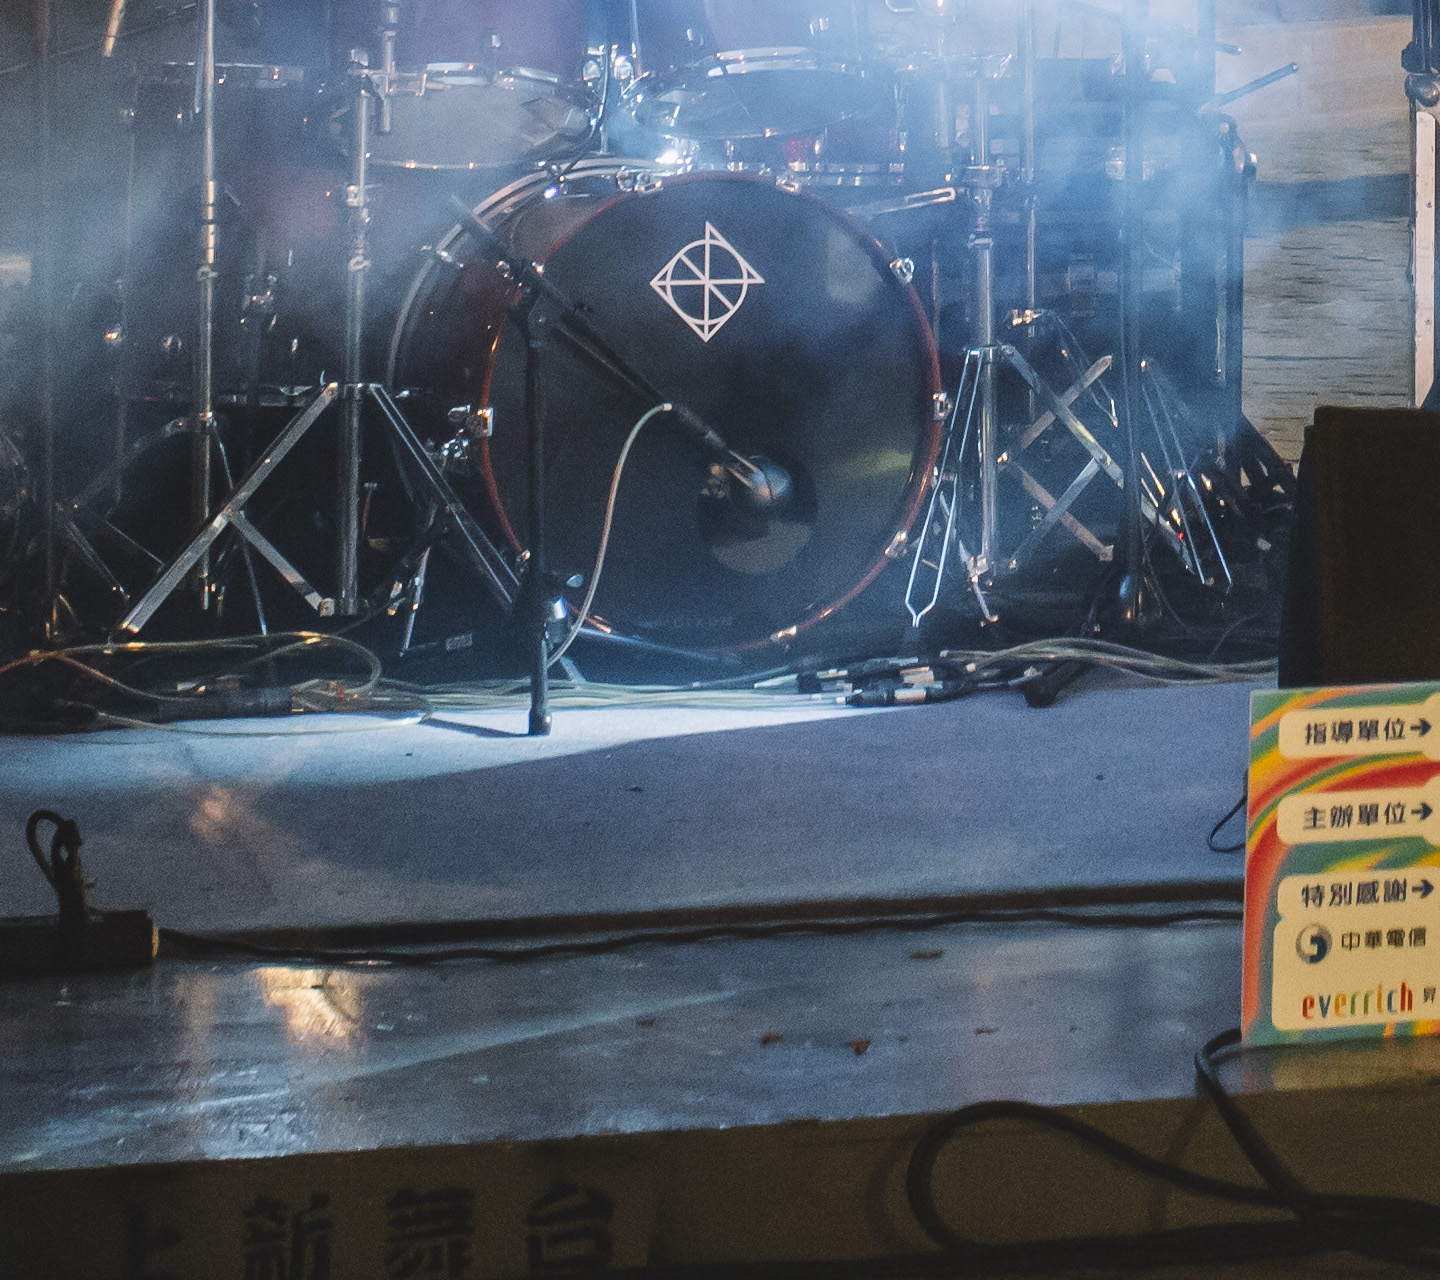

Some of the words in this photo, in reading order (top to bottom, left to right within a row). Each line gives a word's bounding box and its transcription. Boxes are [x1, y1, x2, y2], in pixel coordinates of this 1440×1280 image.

[1304, 717, 1407, 746] 指導單位
[1303, 801, 1407, 830] 主辦單位
[1301, 878, 1407, 908] 特別感謝
[1341, 927, 1427, 951] 中華電信
[1302, 982, 1414, 1020] everrich
